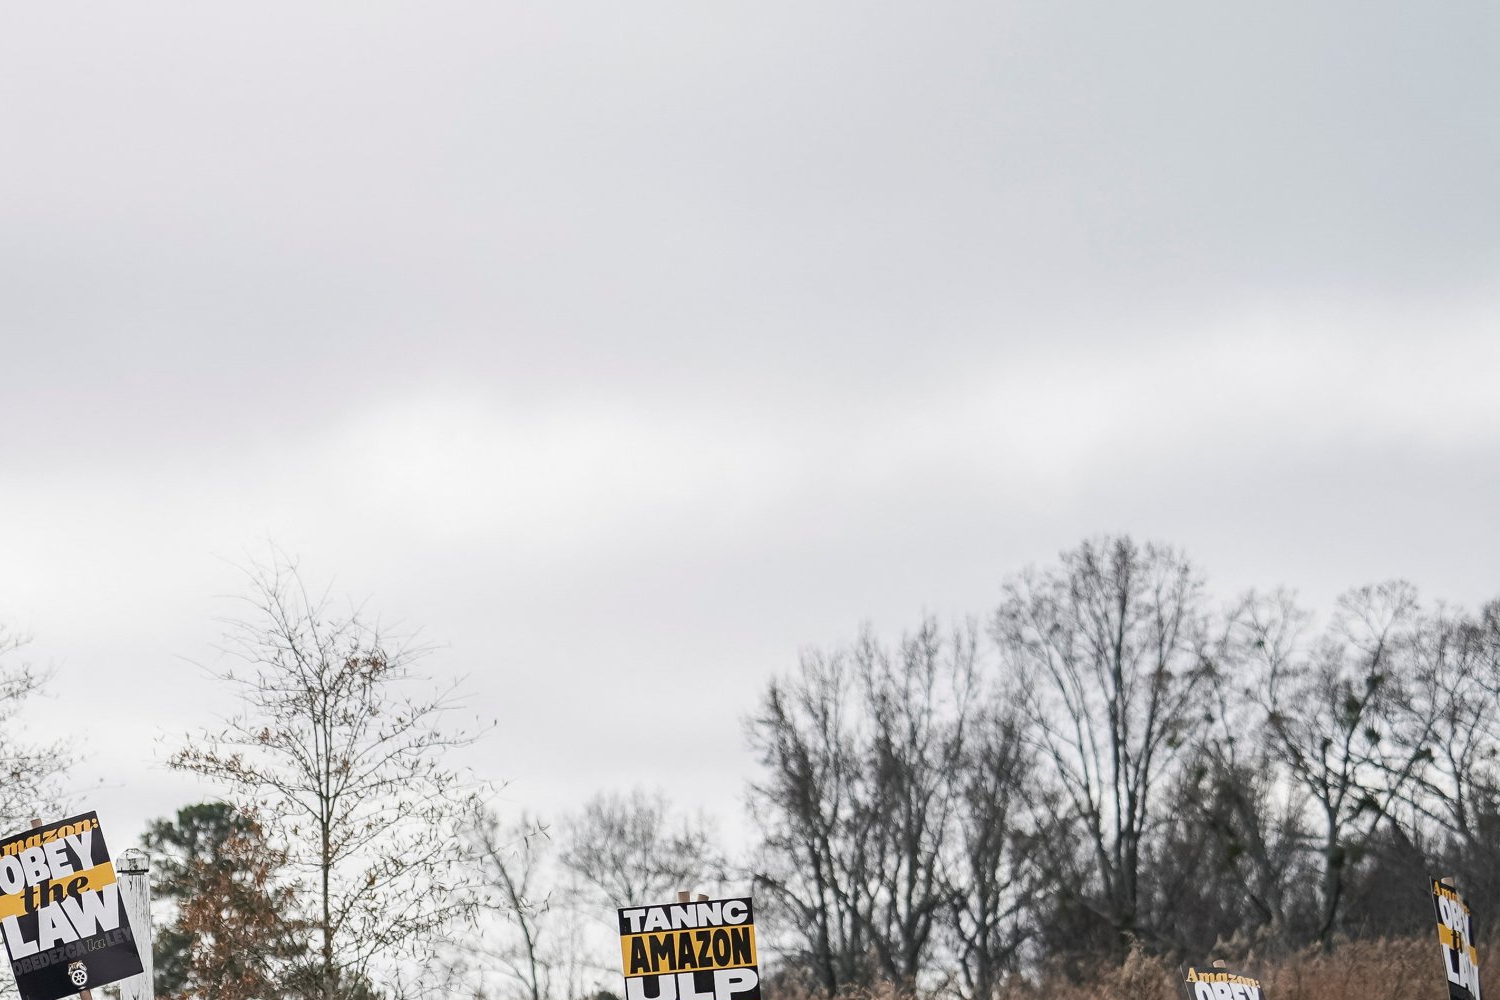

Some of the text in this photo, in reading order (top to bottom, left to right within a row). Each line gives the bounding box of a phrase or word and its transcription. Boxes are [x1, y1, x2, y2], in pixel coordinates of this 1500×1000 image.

[19, 875, 91, 915] the
[623, 900, 749, 934] TANNC
[1, 882, 121, 961] LAW
[630, 926, 753, 975] AMAZON
